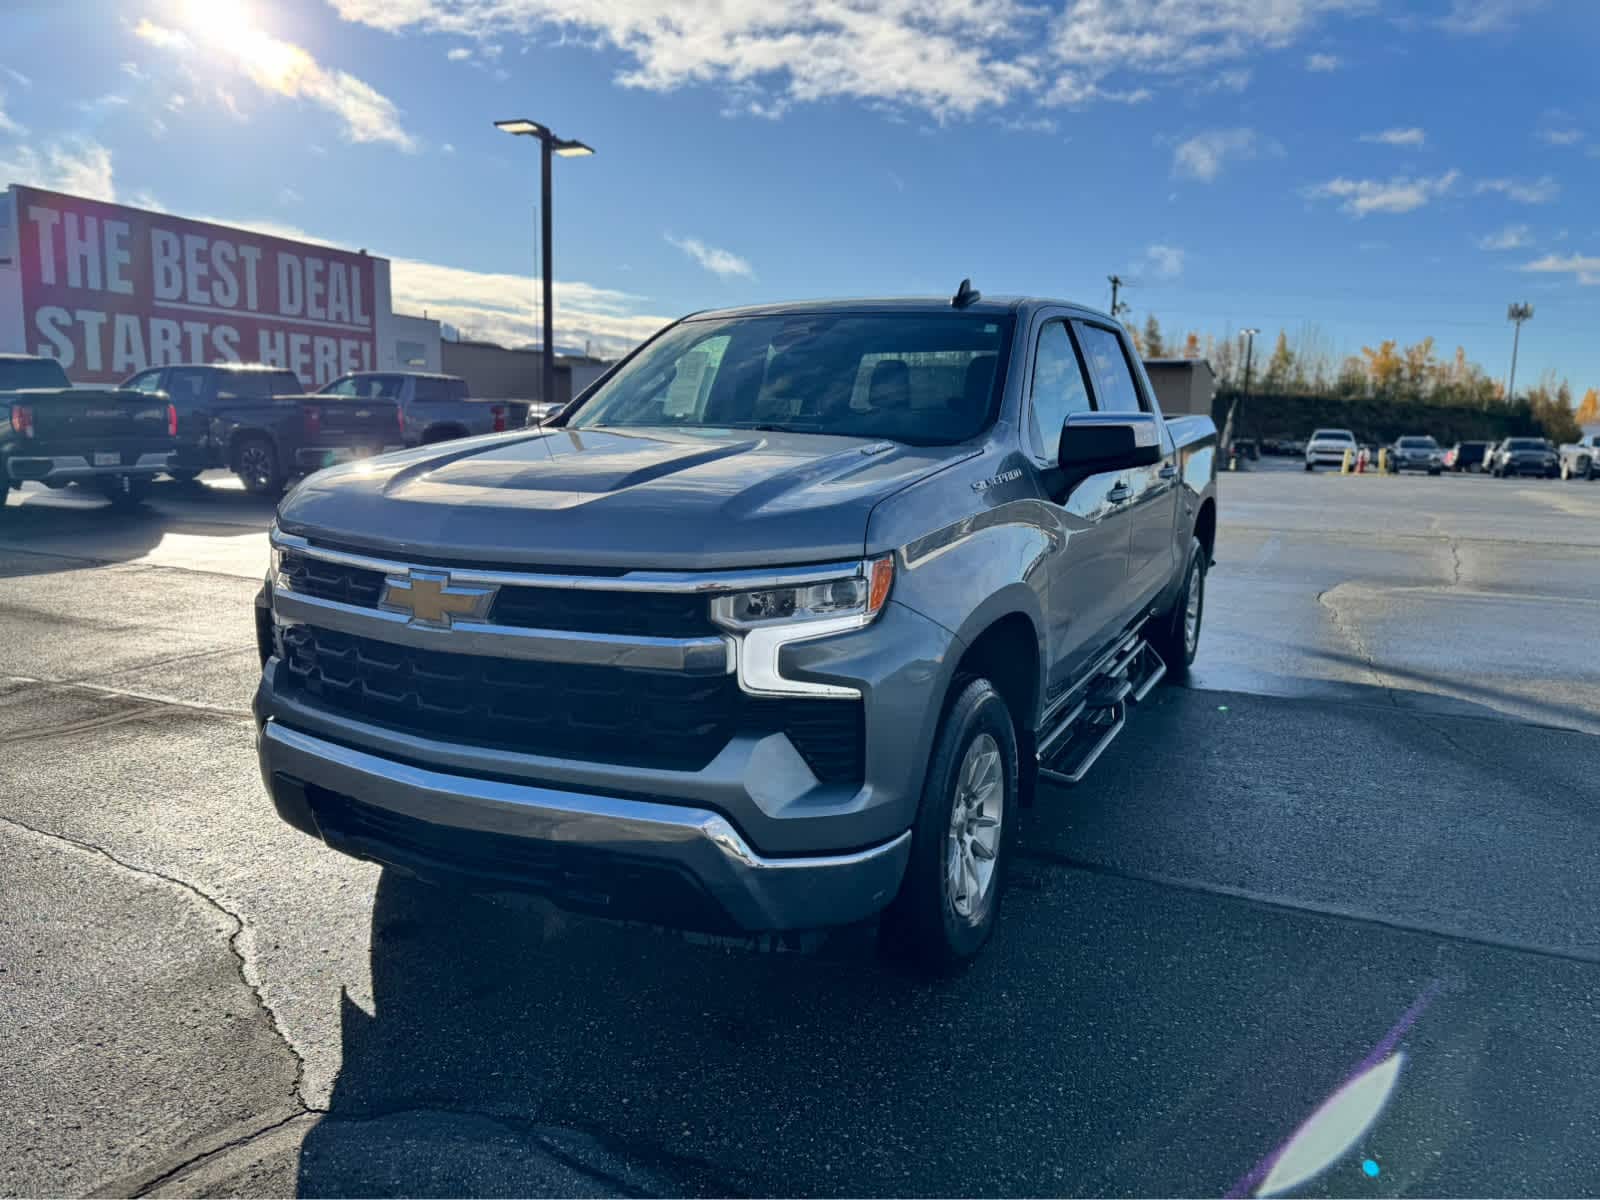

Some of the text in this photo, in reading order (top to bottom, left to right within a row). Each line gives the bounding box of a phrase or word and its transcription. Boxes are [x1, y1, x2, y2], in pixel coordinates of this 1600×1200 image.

[28, 205, 370, 325] THE BEST DEAL
[35, 305, 372, 384] STARTS HERE!
